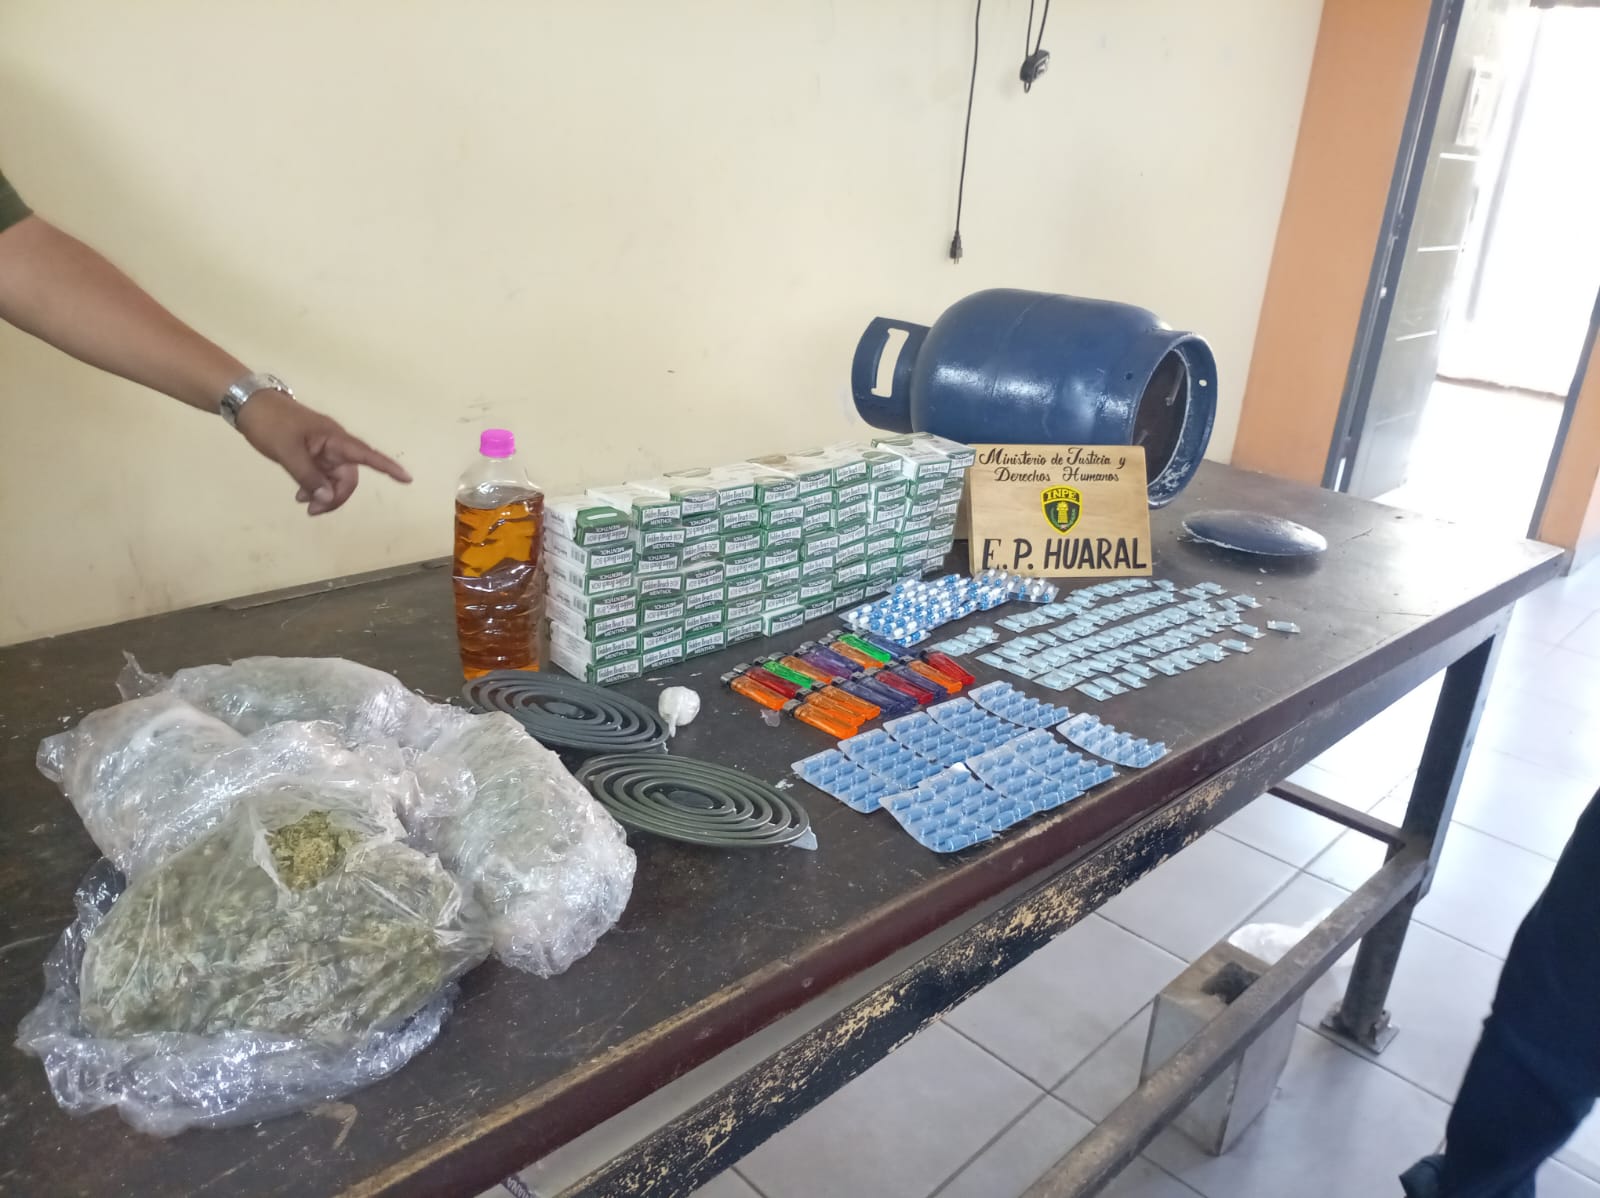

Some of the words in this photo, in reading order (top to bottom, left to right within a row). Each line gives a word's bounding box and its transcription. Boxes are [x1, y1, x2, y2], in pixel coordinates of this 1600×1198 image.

[978, 447, 1046, 465] Ministerio
[1051, 453, 1064, 465] de
[1066, 447, 1111, 465] Justicia
[1119, 455, 1126, 469] y
[994, 467, 1050, 482] Derechos
[1062, 466, 1120, 482] Humanos
[1046, 489, 1077, 500] INPE
[1043, 538, 1147, 570] HUARAL
